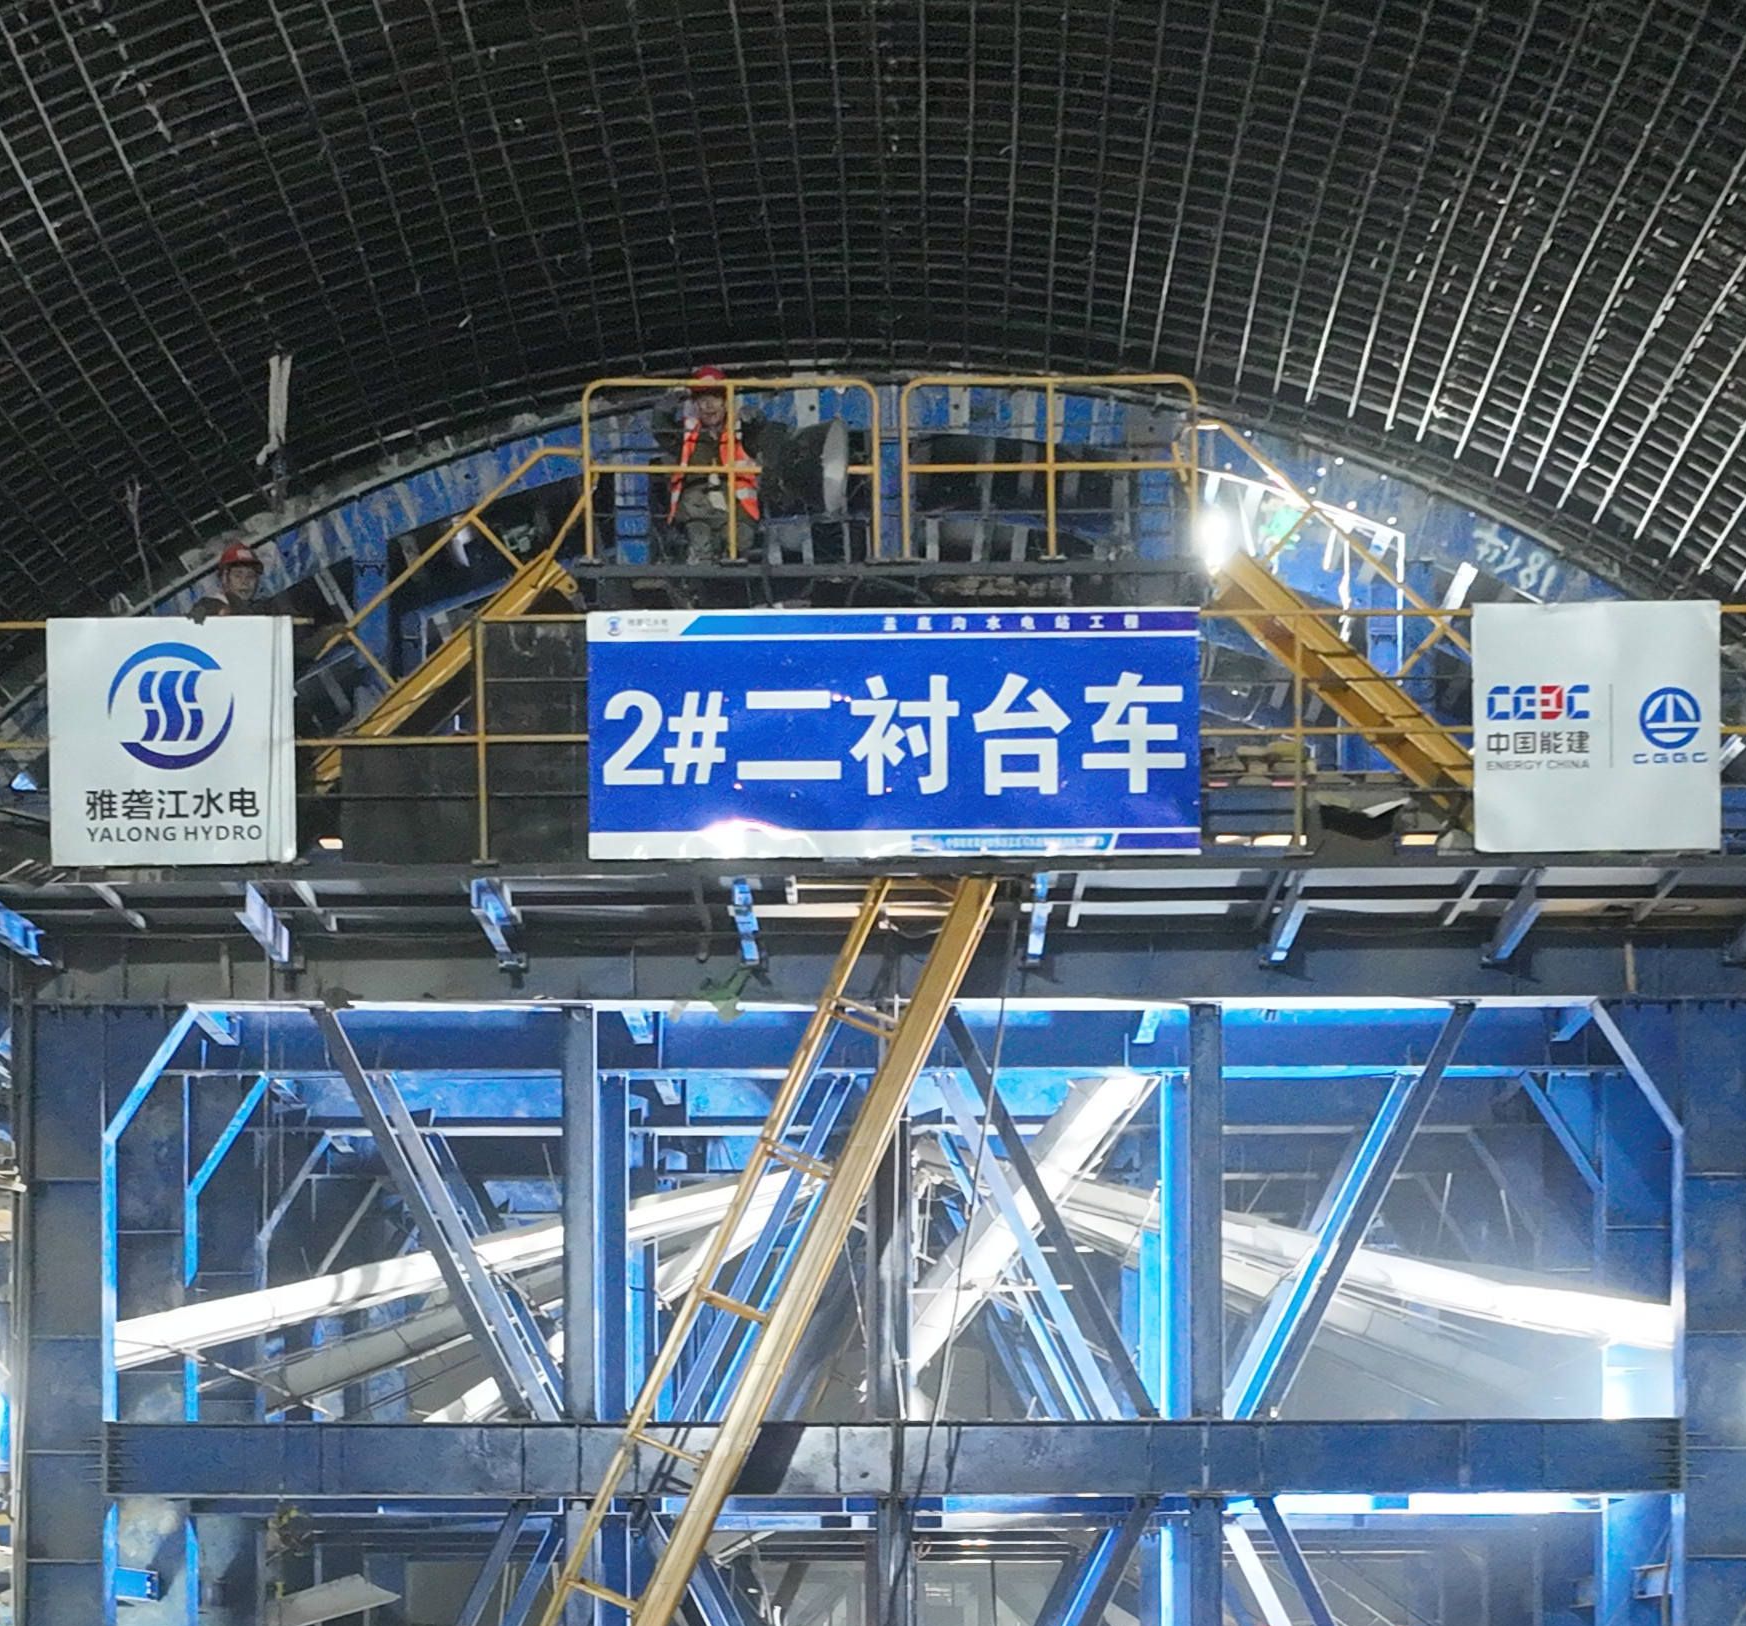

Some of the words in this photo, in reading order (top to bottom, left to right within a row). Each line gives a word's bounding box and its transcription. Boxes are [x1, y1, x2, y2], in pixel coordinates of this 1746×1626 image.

[602, 671, 1186, 796] 2#二衬台车
[1487, 731, 1590, 755] 中国能建
[1486, 761, 1542, 771] ENERGY
[1546, 759, 1590, 770] CHINA
[85, 787, 260, 821] 雅砻江水电
[86, 826, 177, 842] YALONG
[184, 825, 262, 840] HYDRO
